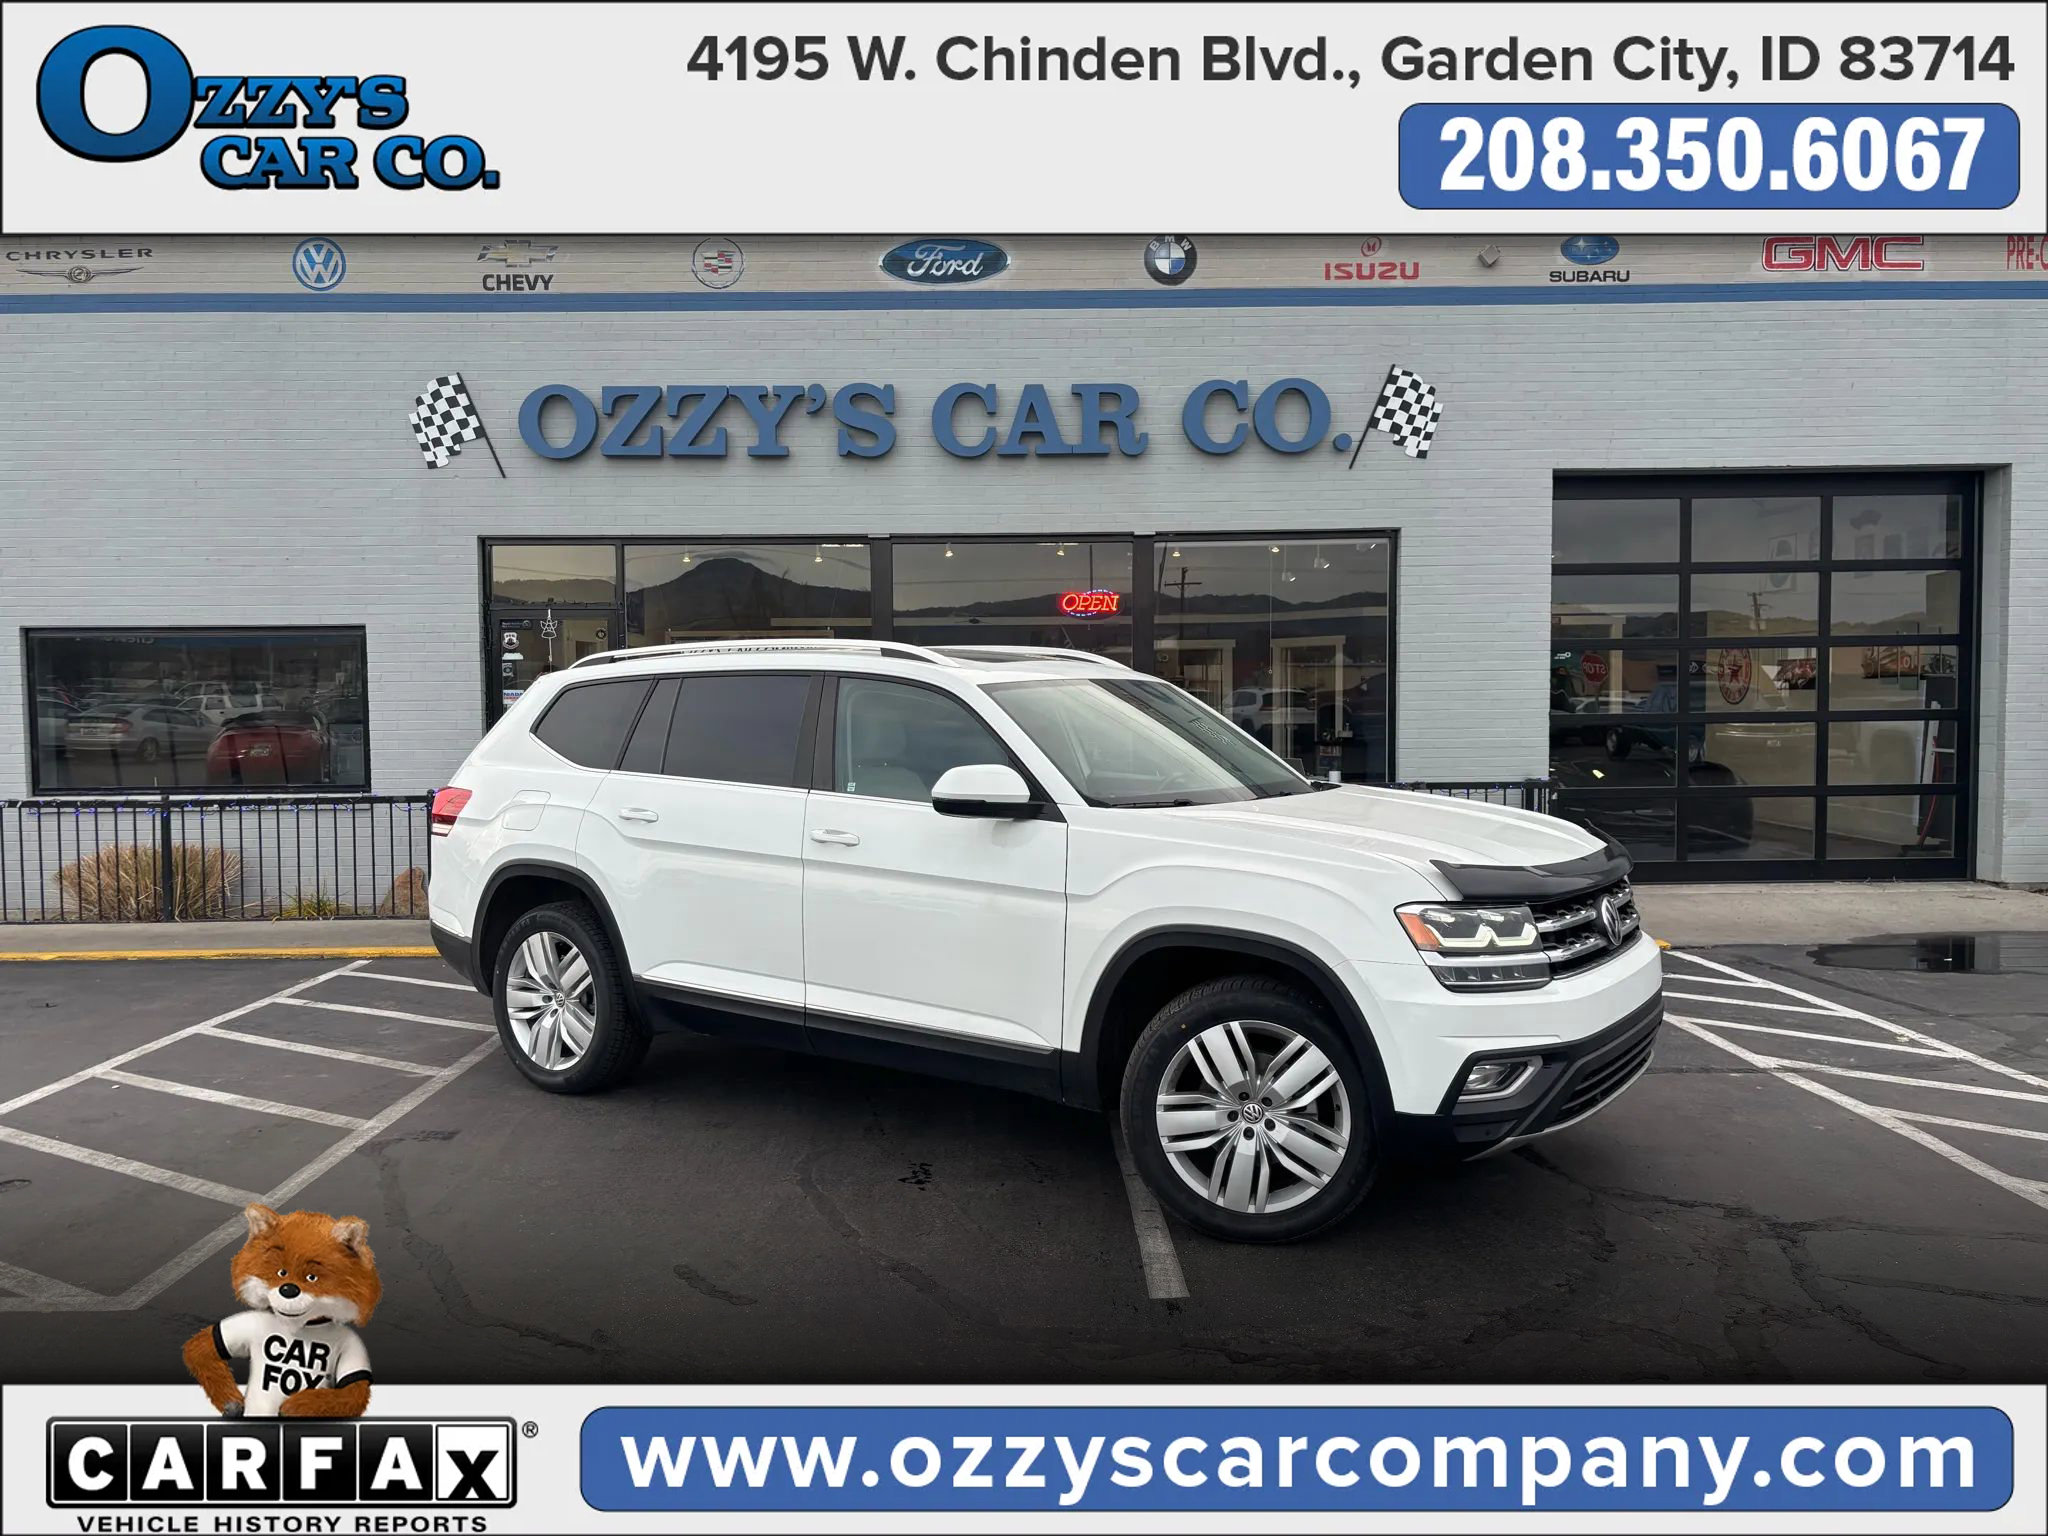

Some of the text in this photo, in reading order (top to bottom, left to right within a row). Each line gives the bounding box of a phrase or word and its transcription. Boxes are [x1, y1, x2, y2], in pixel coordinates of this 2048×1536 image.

[5, 248, 153, 262] CHRYSLER
[906, 244, 985, 277] Ford
[1762, 235, 1925, 272] GMC
[1324, 261, 1420, 281] ISUZU
[1548, 269, 1631, 283] SUBARU
[481, 273, 554, 292] CHEVY
[517, 377, 1353, 460] OZZY'S CAR CO.
[1061, 593, 1120, 612] OPEN
